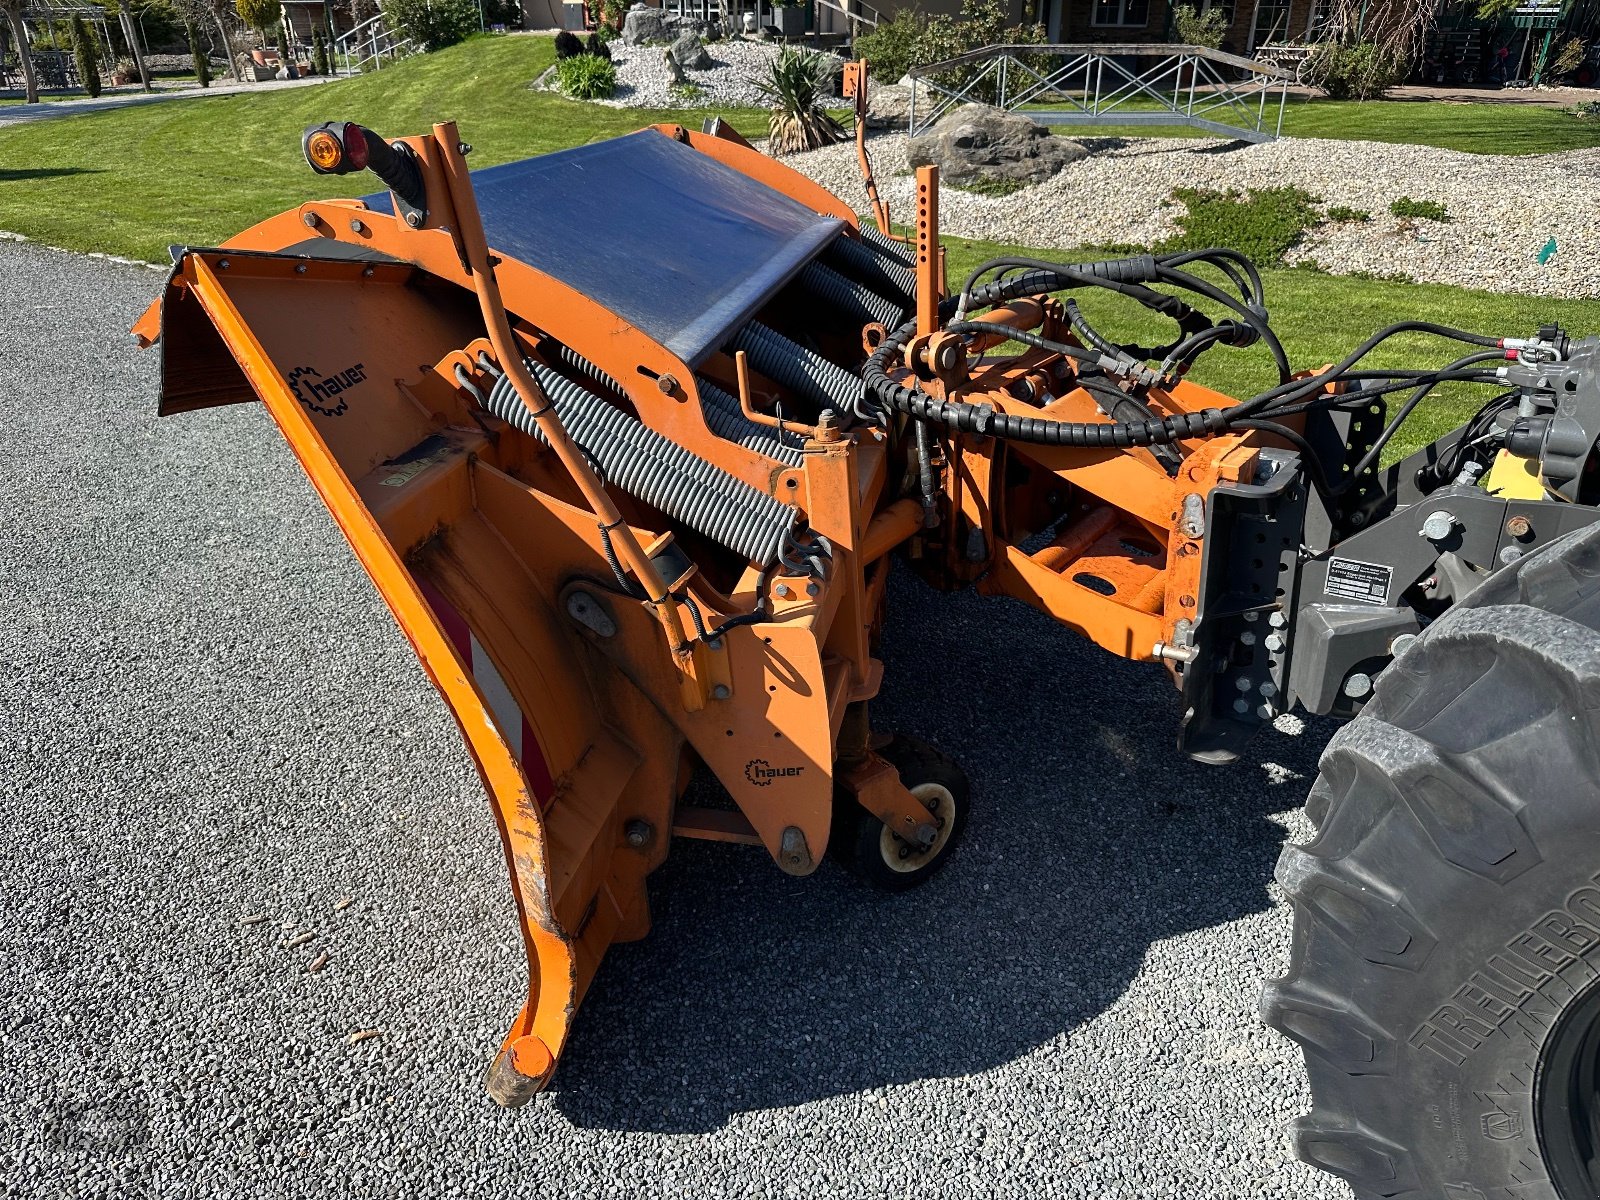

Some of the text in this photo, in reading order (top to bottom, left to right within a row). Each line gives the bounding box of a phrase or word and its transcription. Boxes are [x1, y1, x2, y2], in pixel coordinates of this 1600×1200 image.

[302, 363, 367, 402] hauer
[755, 766, 804, 778] hauer
[1408, 870, 1600, 1067] TRELLEBO
